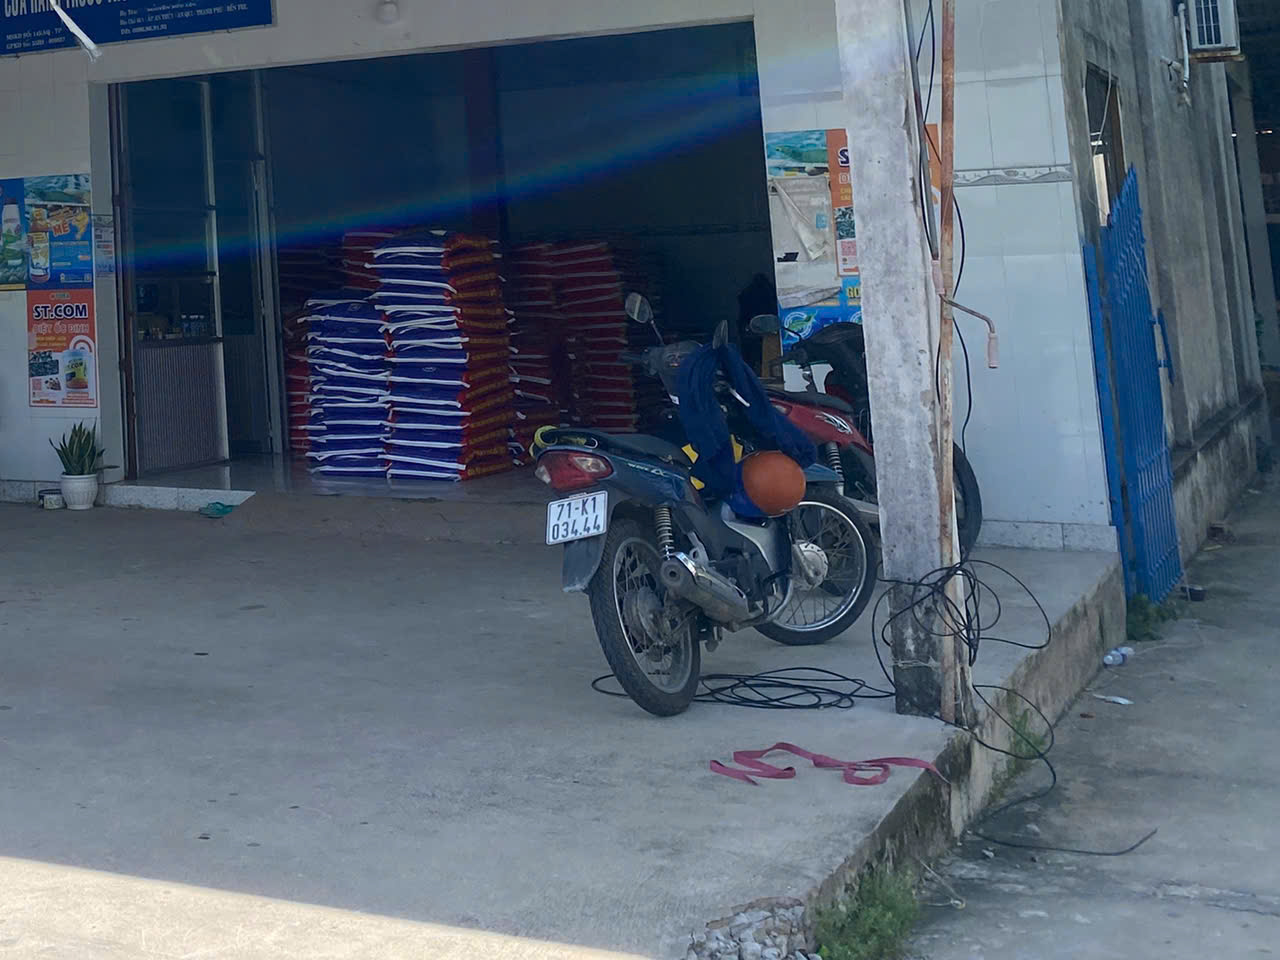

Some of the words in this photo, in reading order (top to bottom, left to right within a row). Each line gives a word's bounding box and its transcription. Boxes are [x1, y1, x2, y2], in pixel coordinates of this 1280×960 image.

[33, 304, 88, 319] ST.COM
[557, 497, 596, 521] 71-K1
[552, 514, 600, 540] 034.44
